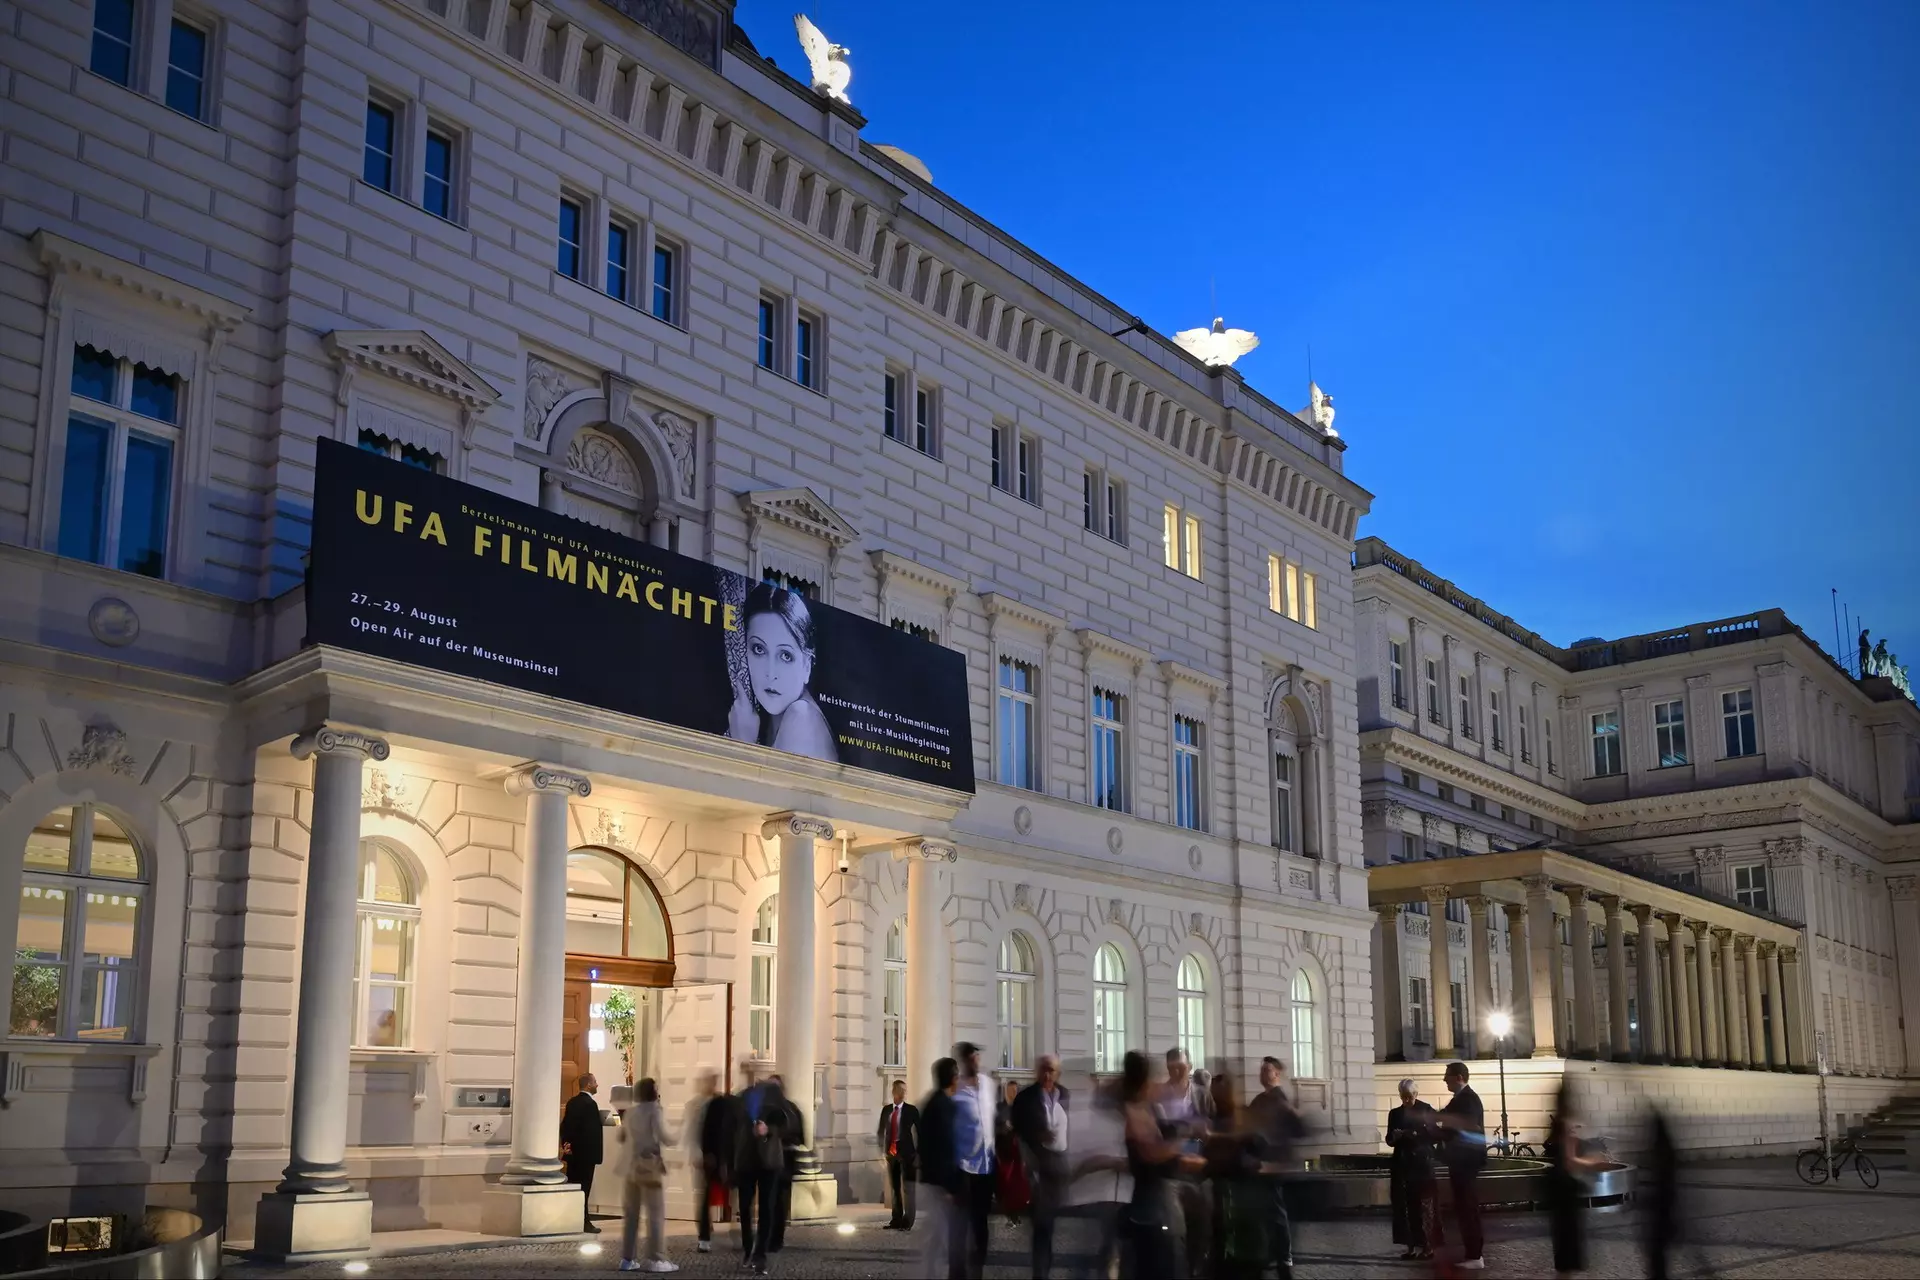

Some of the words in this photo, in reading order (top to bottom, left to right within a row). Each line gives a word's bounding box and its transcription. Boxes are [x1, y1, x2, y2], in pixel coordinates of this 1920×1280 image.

[355, 488, 448, 546] UFA
[474, 525, 738, 632] FILMNÄCHTE
[461, 504, 537, 536] Bertelsmann
[543, 532, 563, 544] und
[569, 540, 589, 553] UFA
[594, 549, 664, 576] präsentieren
[410, 607, 457, 628] August
[350, 616, 387, 634] Open
[393, 627, 414, 641] Air
[419, 635, 441, 646] auf
[446, 639, 468, 653] der
[473, 646, 558, 676] Museumsinsel
[819, 692, 876, 715] Meisterwerke
[878, 709, 892, 720] der
[894, 713, 950, 737] Stummfilmzeit
[849, 720, 864, 730] mit
[866, 723, 950, 755] Live-Musikbegleitung
